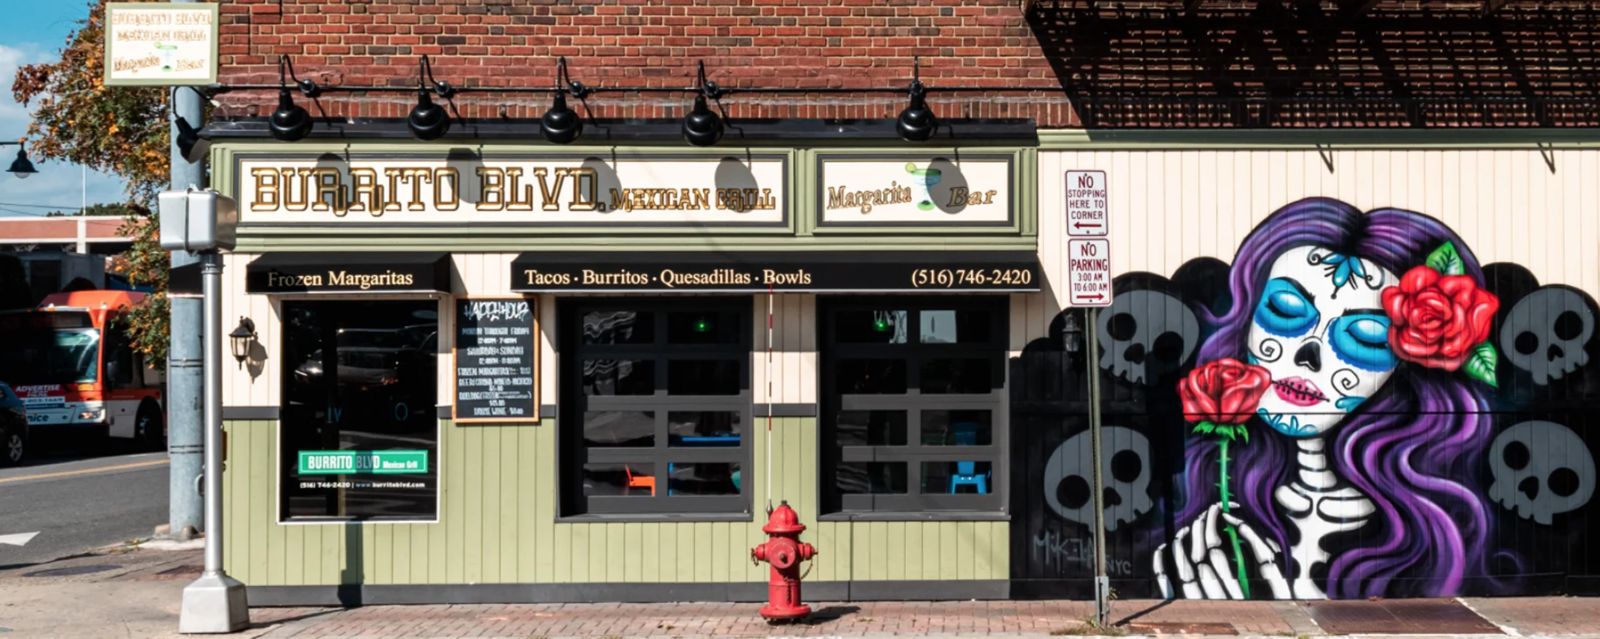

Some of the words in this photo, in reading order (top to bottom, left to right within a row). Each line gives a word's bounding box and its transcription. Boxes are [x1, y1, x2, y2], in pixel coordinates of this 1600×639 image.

[1078, 176, 1094, 188] NO
[251, 167, 460, 217] BURRITO
[609, 187, 710, 212] MEXICAN
[715, 187, 776, 212] GRILL
[827, 180, 912, 214] Margarita
[946, 186, 998, 208] Bar
[1068, 189, 1105, 198] STOPPING
[1069, 199, 1090, 209] HERE
[1094, 199, 1104, 209] TO
[1071, 210, 1103, 220] CORNER
[1081, 244, 1097, 257] NO
[1071, 259, 1108, 272] PARKING
[268, 271, 322, 287] Frozen
[328, 270, 413, 289] Margaritas
[524, 269, 570, 285] Tacos
[582, 269, 648, 285] Burritos
[660, 269, 751, 287] Quesadillas
[763, 269, 811, 285] Bowls
[911, 269, 954, 288] (516)
[956, 269, 1031, 284] 746-2420
[1078, 272, 1092, 282] 3:00
[1093, 272, 1103, 282] AM
[1074, 282, 1081, 292] TO
[1082, 282, 1097, 292] 6:00
[1098, 282, 1108, 292] AM
[15, 384, 60, 393] ADVERTISE
[308, 455, 352, 469] BURRITO
[356, 455, 380, 469] BLVD
